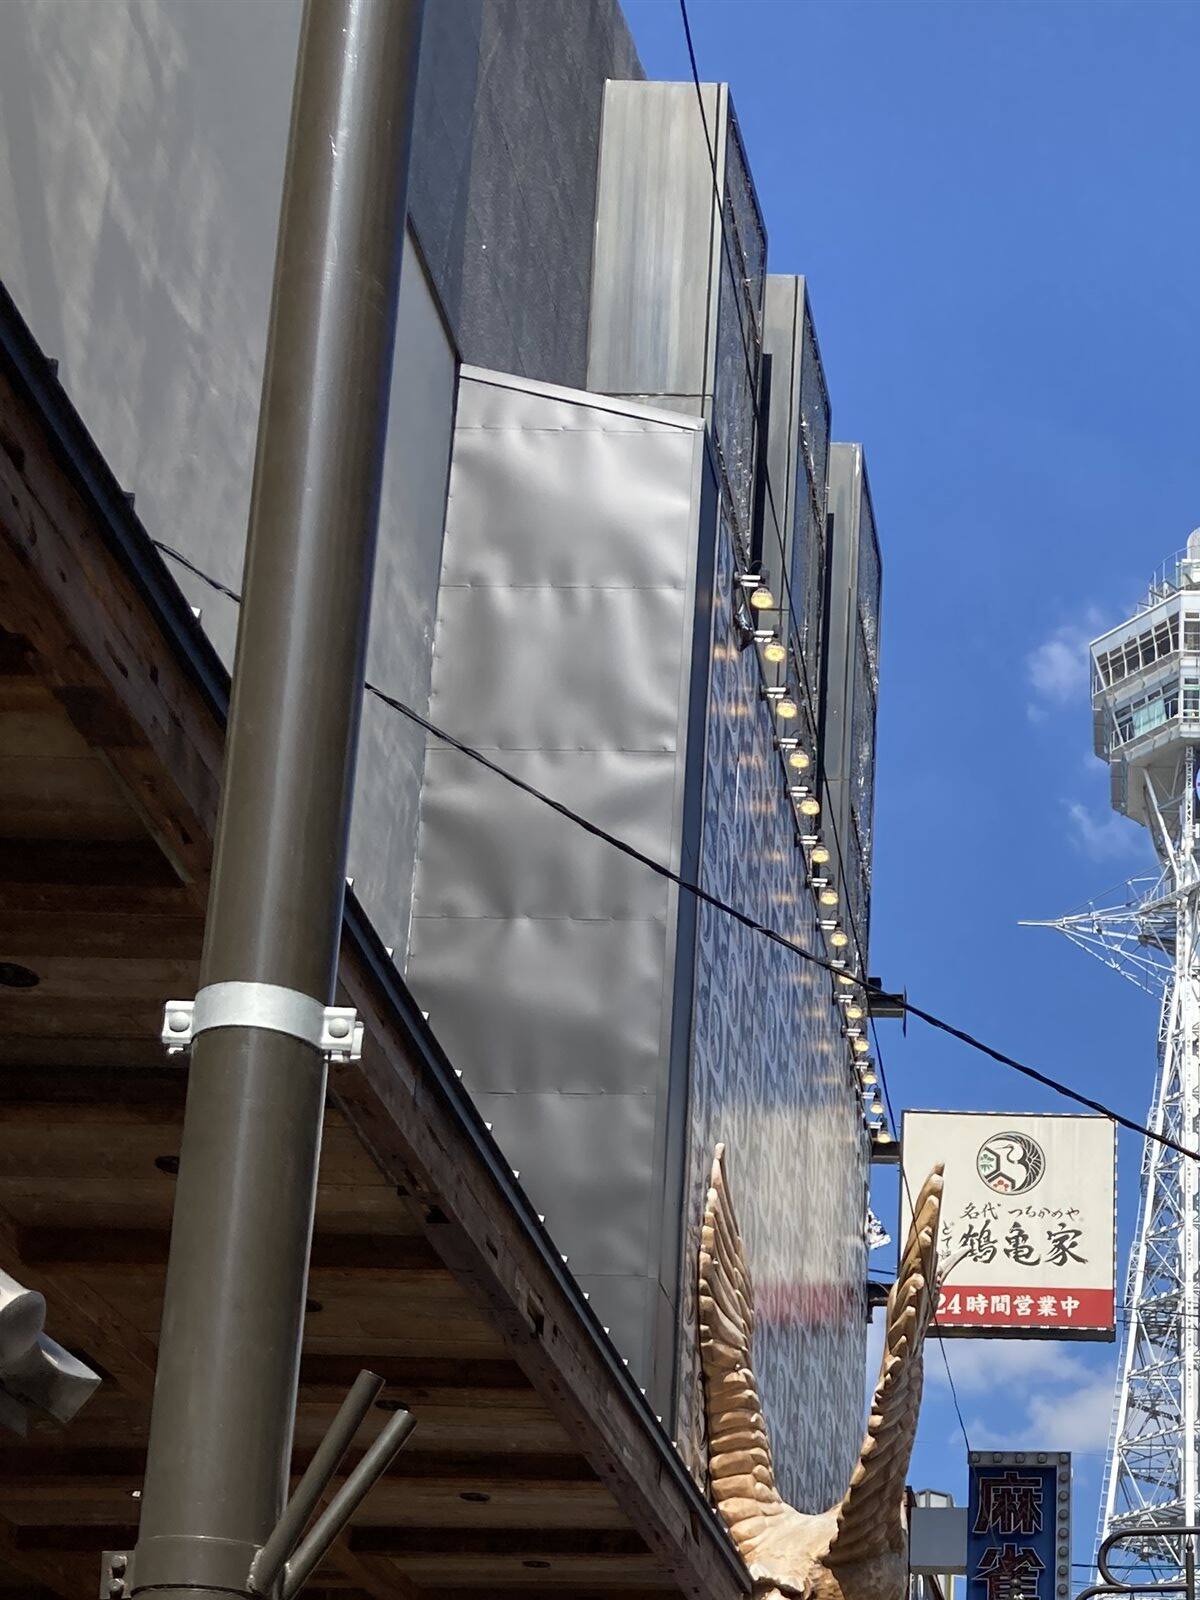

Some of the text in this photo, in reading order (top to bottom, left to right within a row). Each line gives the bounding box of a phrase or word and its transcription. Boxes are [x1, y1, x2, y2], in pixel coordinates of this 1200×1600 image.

[959, 1219, 1089, 1267] 鶴亀家
[936, 1293, 1080, 1318] 24時間営業中
